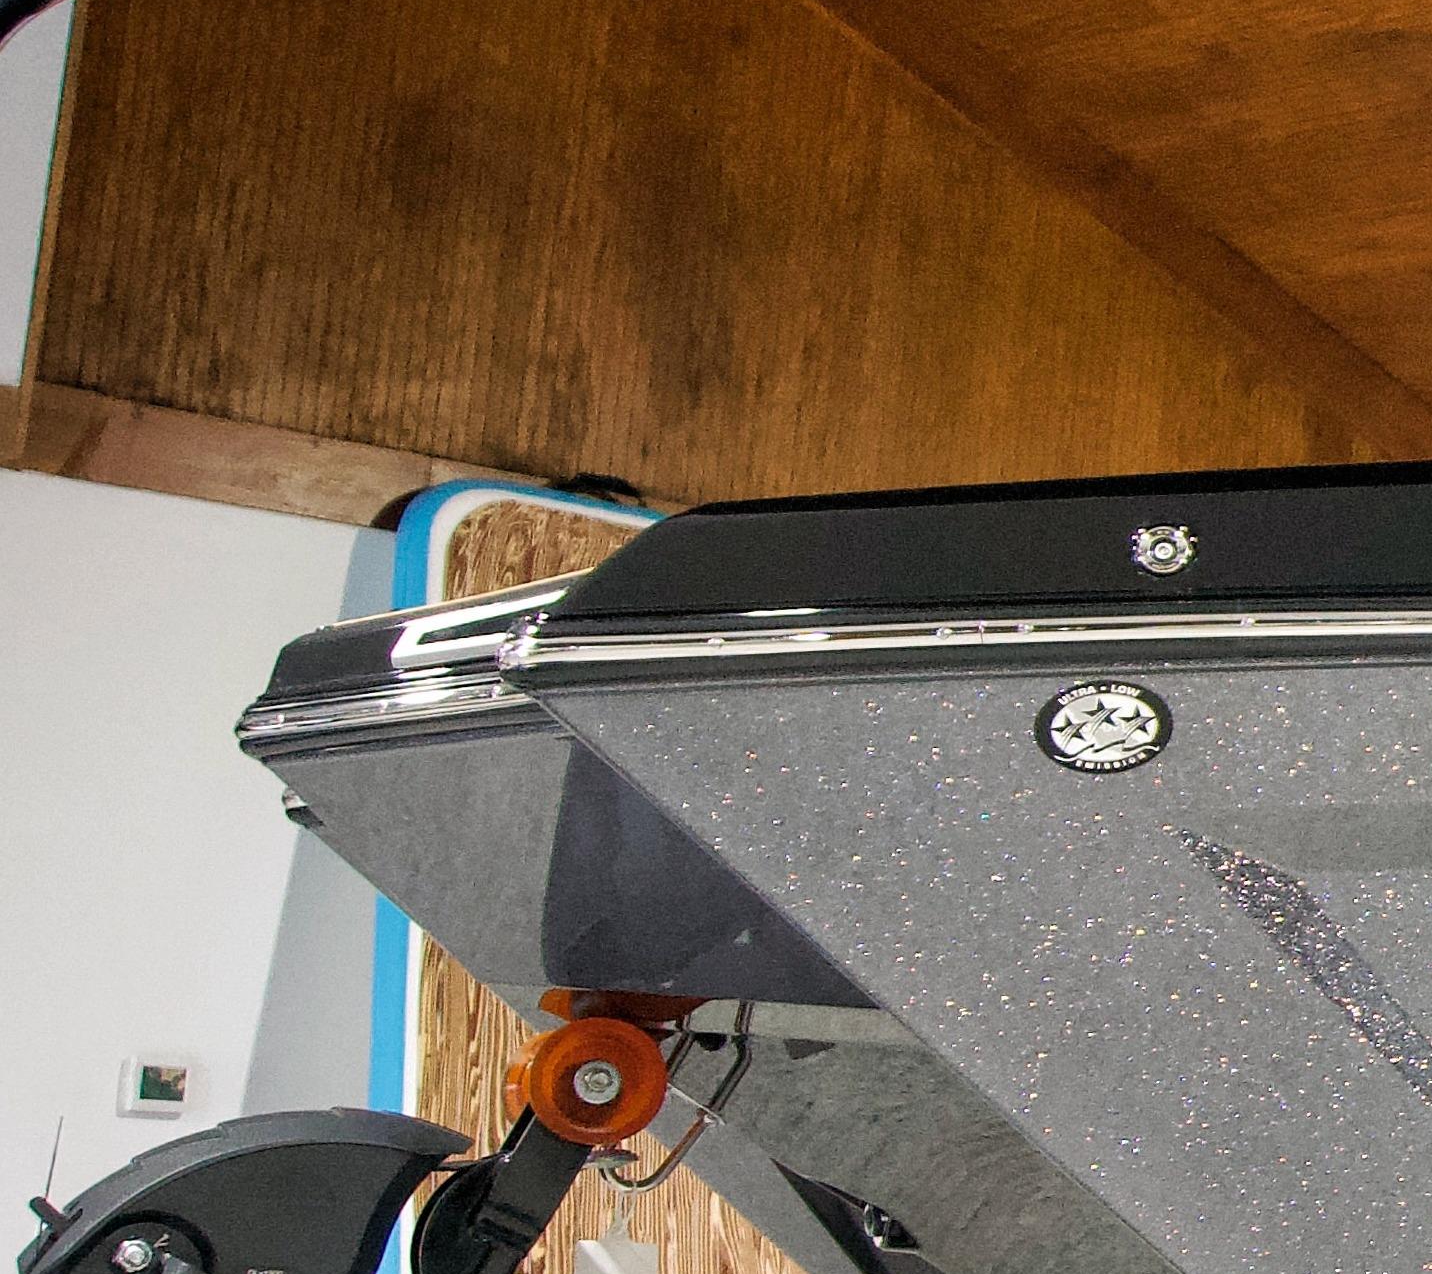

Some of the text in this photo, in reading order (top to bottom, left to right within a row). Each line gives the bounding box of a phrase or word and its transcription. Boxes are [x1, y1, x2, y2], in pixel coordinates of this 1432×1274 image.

[1057, 684, 1141, 706] ULTRA LOW
[1075, 752, 1147, 770] EMISSION
